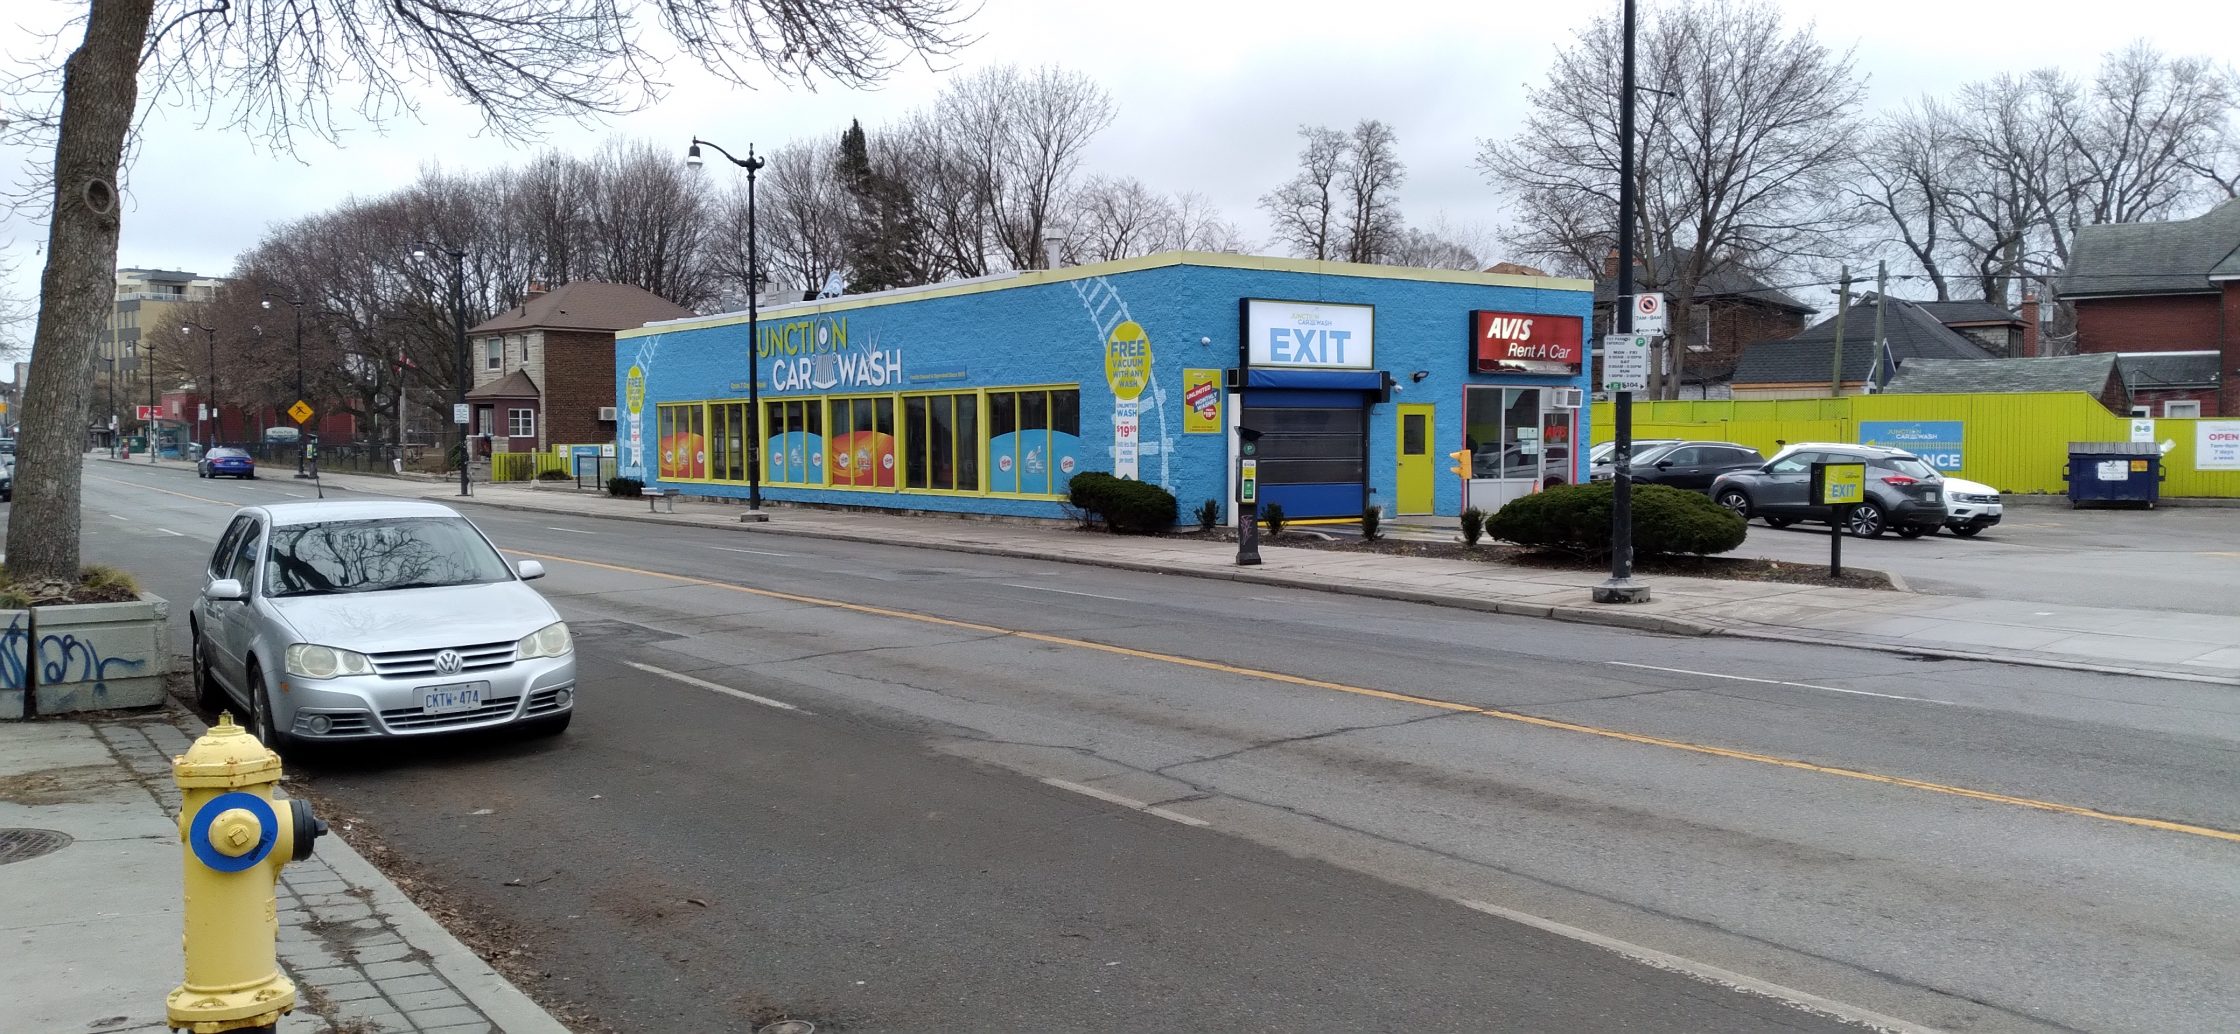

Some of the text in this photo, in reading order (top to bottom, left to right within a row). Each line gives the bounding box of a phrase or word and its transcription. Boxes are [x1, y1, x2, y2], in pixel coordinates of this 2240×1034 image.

[748, 316, 848, 358] UNCTION
[1487, 317, 1533, 340] AVIS
[1111, 339, 1146, 358] FREE
[1270, 328, 1351, 363] EXIT
[1507, 343, 1572, 359] Rent A Car
[772, 349, 902, 391] CAR WASH
[1112, 358, 1143, 368] VACUUM
[1186, 384, 1212, 400] UNLIMITED
[1117, 409, 1137, 417] WASH
[2208, 433, 2239, 441] OPEN
[1832, 484, 1856, 497] EXIT
[425, 690, 479, 708] CKTW 474
